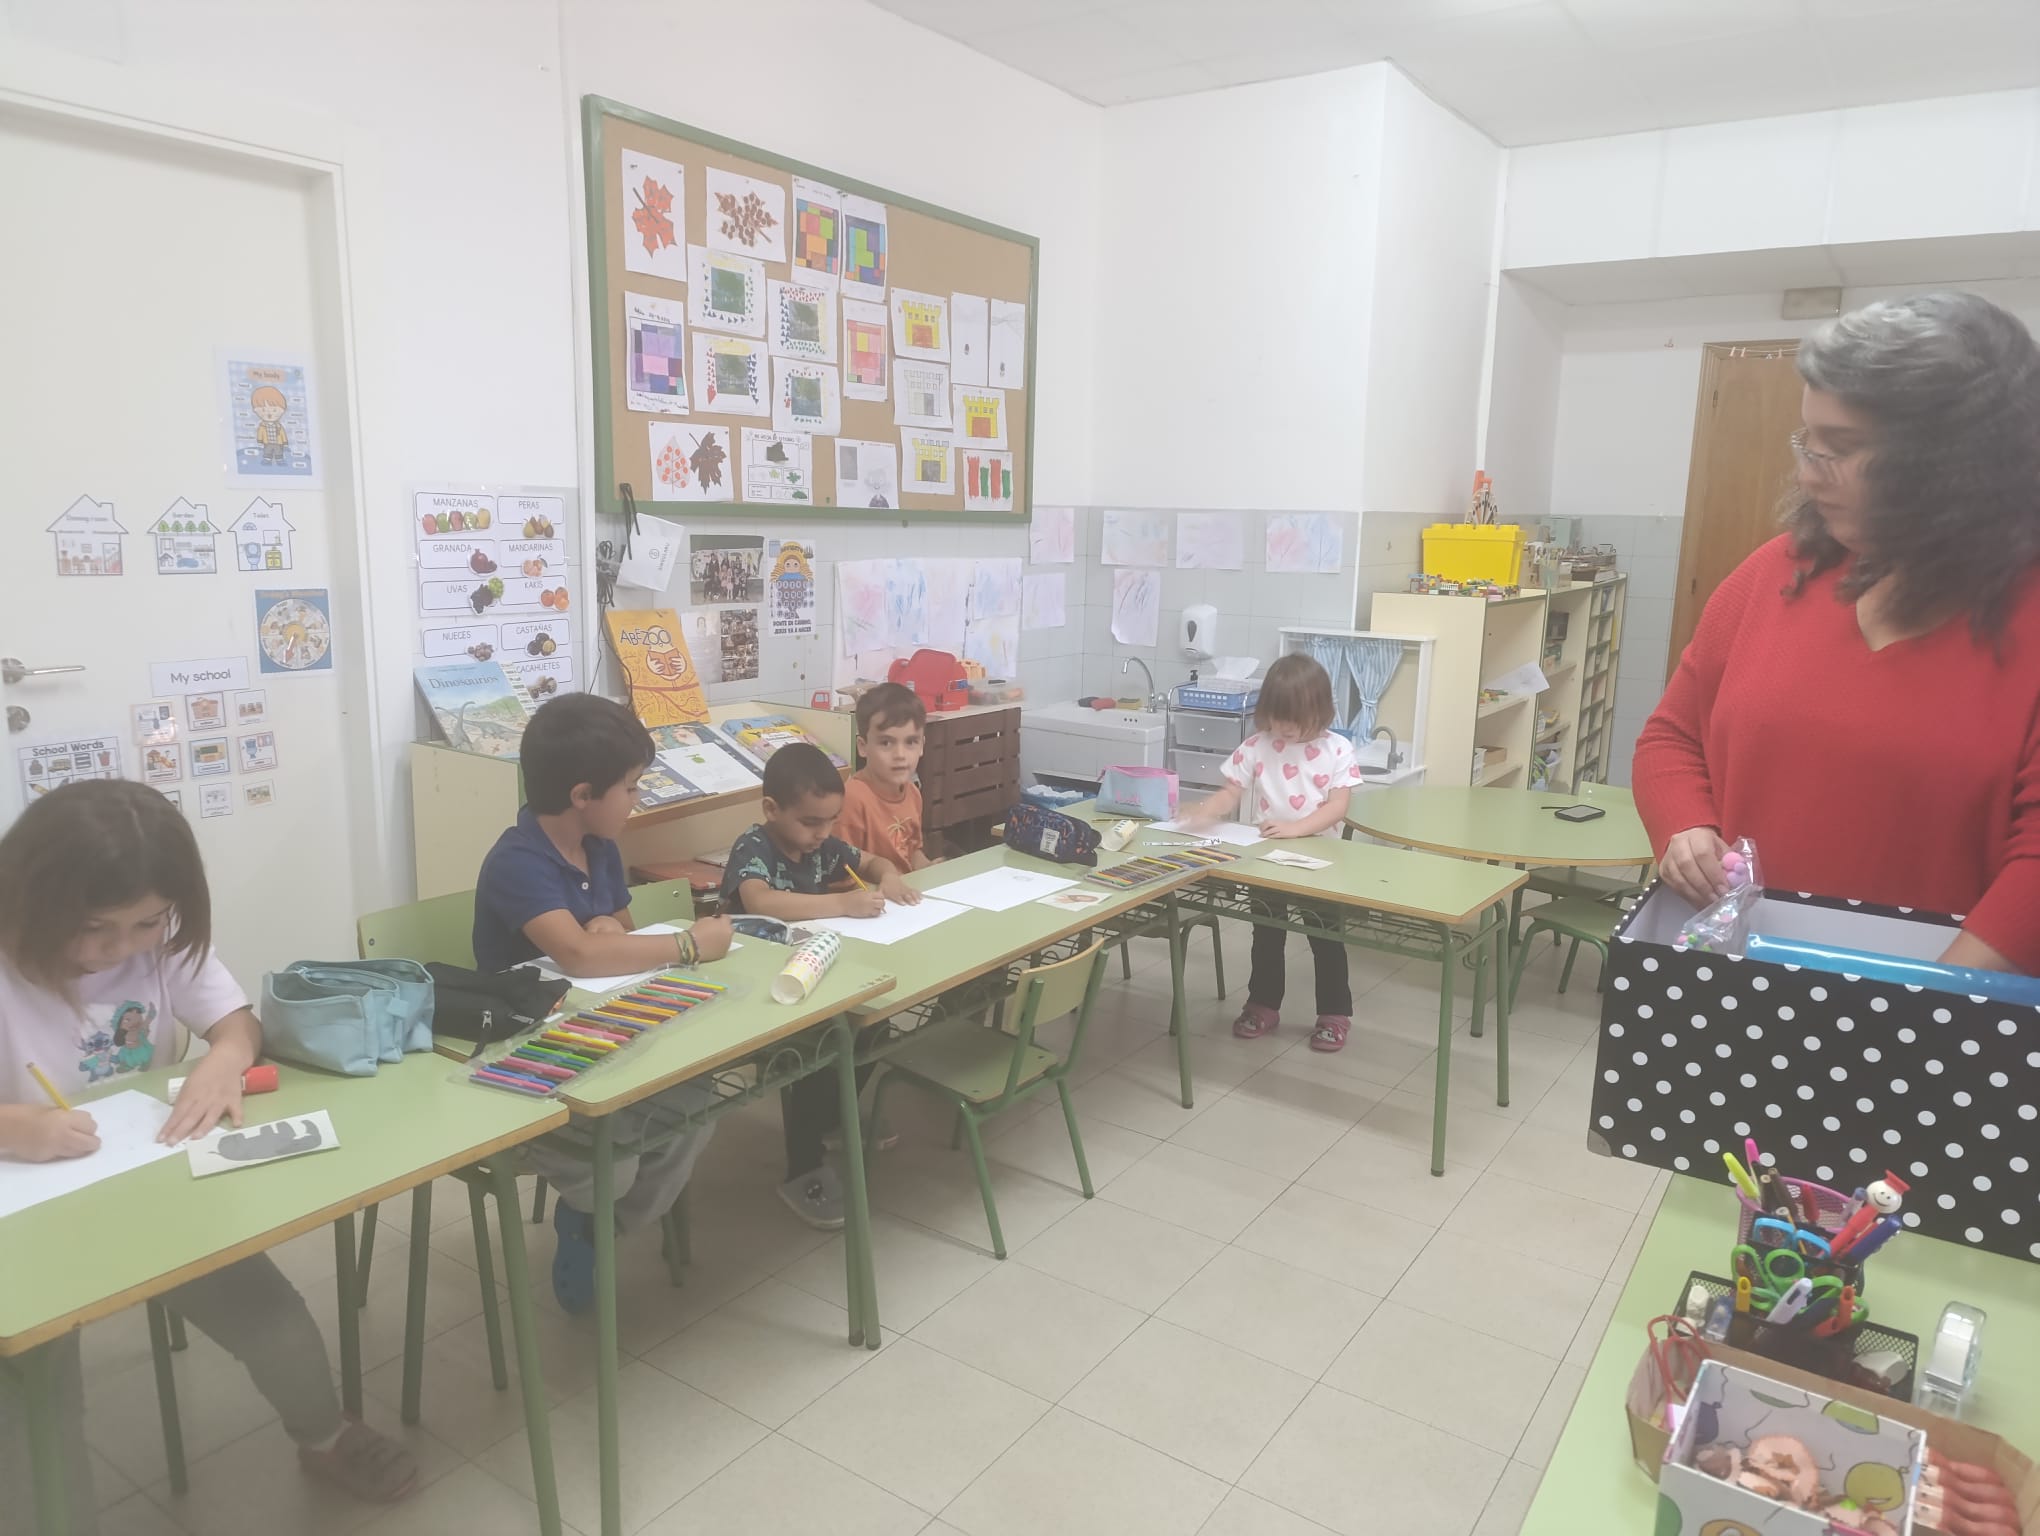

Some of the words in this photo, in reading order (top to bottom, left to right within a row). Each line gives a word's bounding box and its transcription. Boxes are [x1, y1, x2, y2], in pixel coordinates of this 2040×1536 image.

[433, 498, 478, 508] MANZANAS
[518, 500, 540, 510] PERAS
[433, 544, 471, 553] GRANADA
[509, 543, 553, 552] MANDARINAS
[447, 584, 468, 593] UVAS
[524, 580, 544, 589] KAKIS
[516, 623, 552, 634] CASTAÑAS
[442, 630, 471, 640] NUECES
[620, 628, 672, 645] ABEZOO
[516, 662, 561, 673] CACAHUETES
[171, 672, 189, 684] My
[193, 669, 231, 681] school
[428, 674, 499, 689] Dinosaurios
[32, 744, 67, 757] School
[70, 740, 104, 752] Words
